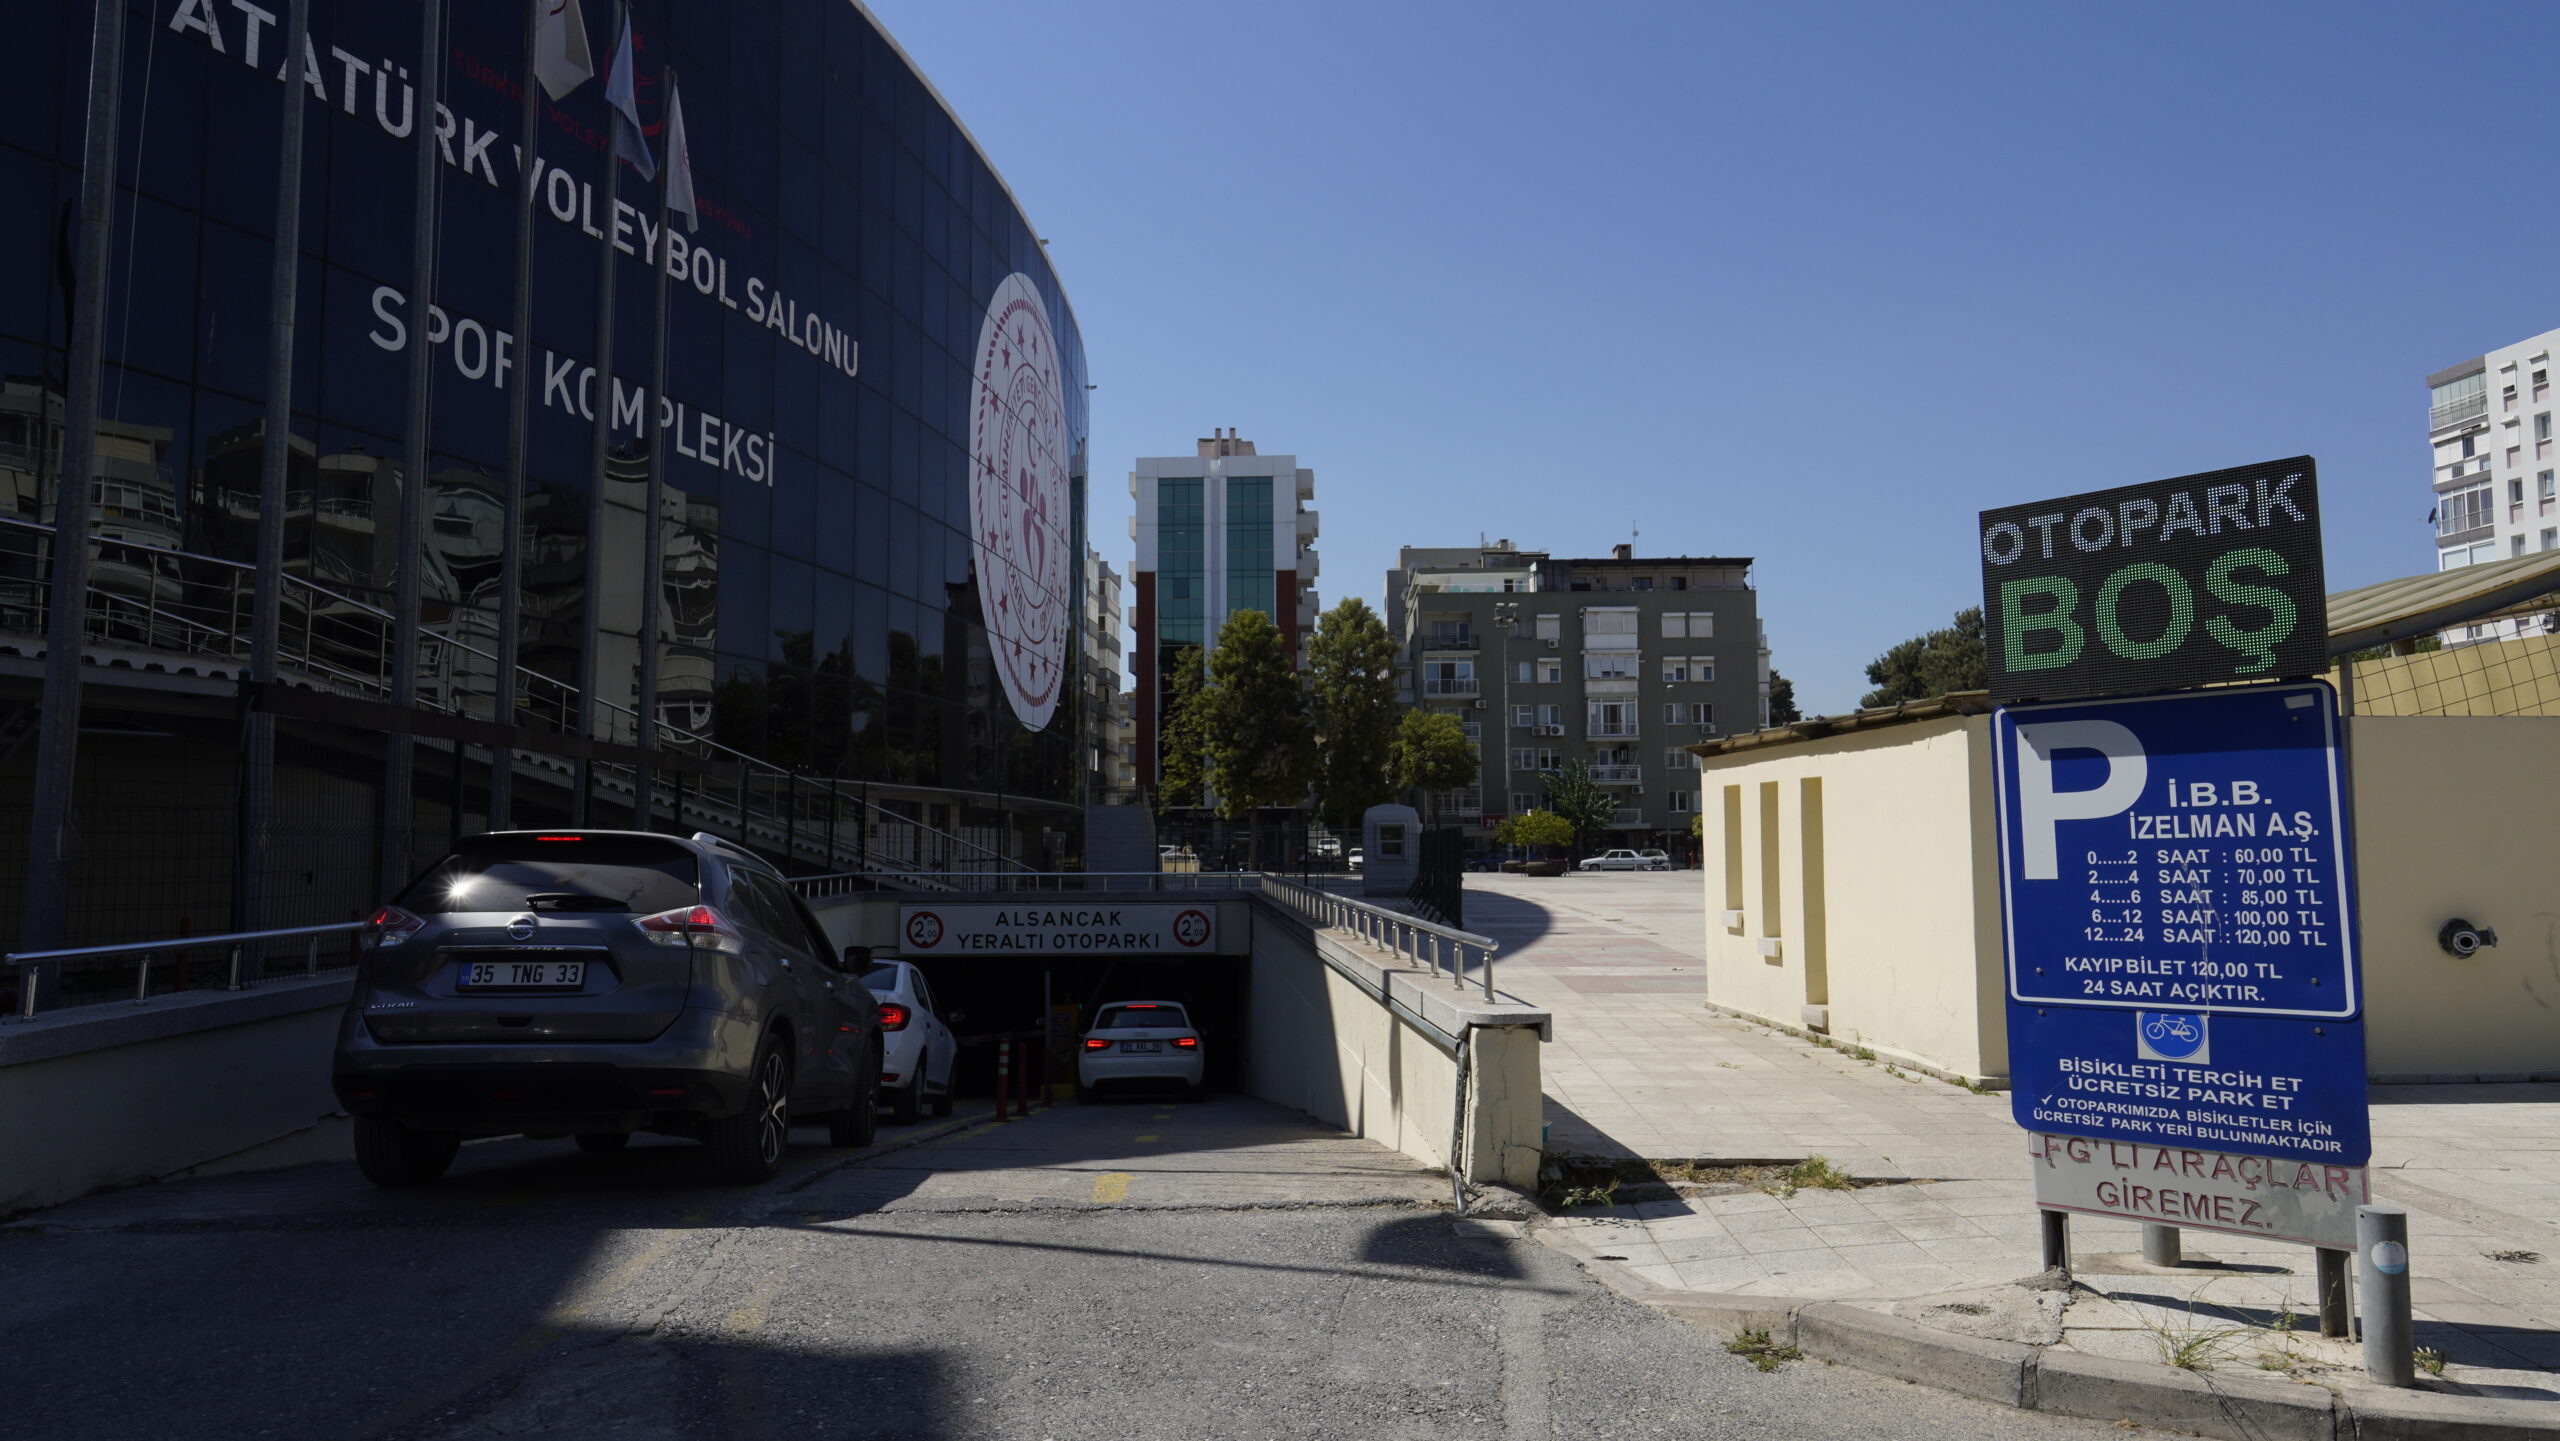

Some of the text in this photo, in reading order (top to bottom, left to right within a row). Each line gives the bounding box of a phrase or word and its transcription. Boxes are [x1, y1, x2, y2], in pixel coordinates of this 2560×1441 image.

[169, 0, 858, 377] ATATÜRK VOLEYBOL SALONU
[1983, 473, 2305, 566] OTOPARK
[2001, 547, 2297, 674] BOŞ
[2016, 719, 2148, 880] P
[2169, 779, 2272, 808] İ.B.B.
[2130, 811, 2319, 843] İZELMAN A.Ş.
[2157, 849, 2210, 864] SAAT
[2234, 848, 2284, 866] 60,00
[2289, 847, 2318, 863] TL
[2158, 869, 2211, 884] SAAT
[2237, 868, 2286, 886] 70,00
[2292, 868, 2320, 884] TL
[2160, 889, 2213, 904] SAAT
[2241, 889, 2288, 907] 85,00
[2295, 889, 2323, 905] TL
[995, 910, 1122, 927] ALSANCAK
[2161, 909, 2216, 924] SAAT
[2234, 910, 2289, 928] 100,00
[2297, 911, 2325, 926] TL
[957, 933, 1160, 950] YERALTI OTOPARKI
[2163, 928, 2216, 943] SAAT
[2235, 929, 2291, 947] 120,00
[2299, 930, 2327, 946] TL
[470, 965, 494, 983] 35
[511, 965, 543, 983] TNG
[556, 965, 580, 983] 33
[2191, 961, 2248, 980] 120,00
[2255, 963, 2283, 979] TL
[2083, 979, 2266, 1002] 24 SAAT AÇIKTIR.
[2059, 1056, 2303, 1092] BİSİKLETİ TERCİH ET
[2068, 1074, 2294, 1111] ÜCRETSİZ PARK ET
[2057, 1097, 2181, 1121] OTOPARKIMIZDA
[2186, 1109, 2293, 1133] BİSİKLETLER
[2033, 1108, 2343, 1154] ÜCRETSİZ PARK YERİ BULUNMAKTADIR
[2153, 1147, 2352, 1195] ARAÇLAR
[2096, 1177, 2273, 1229] GİREMEZ.
